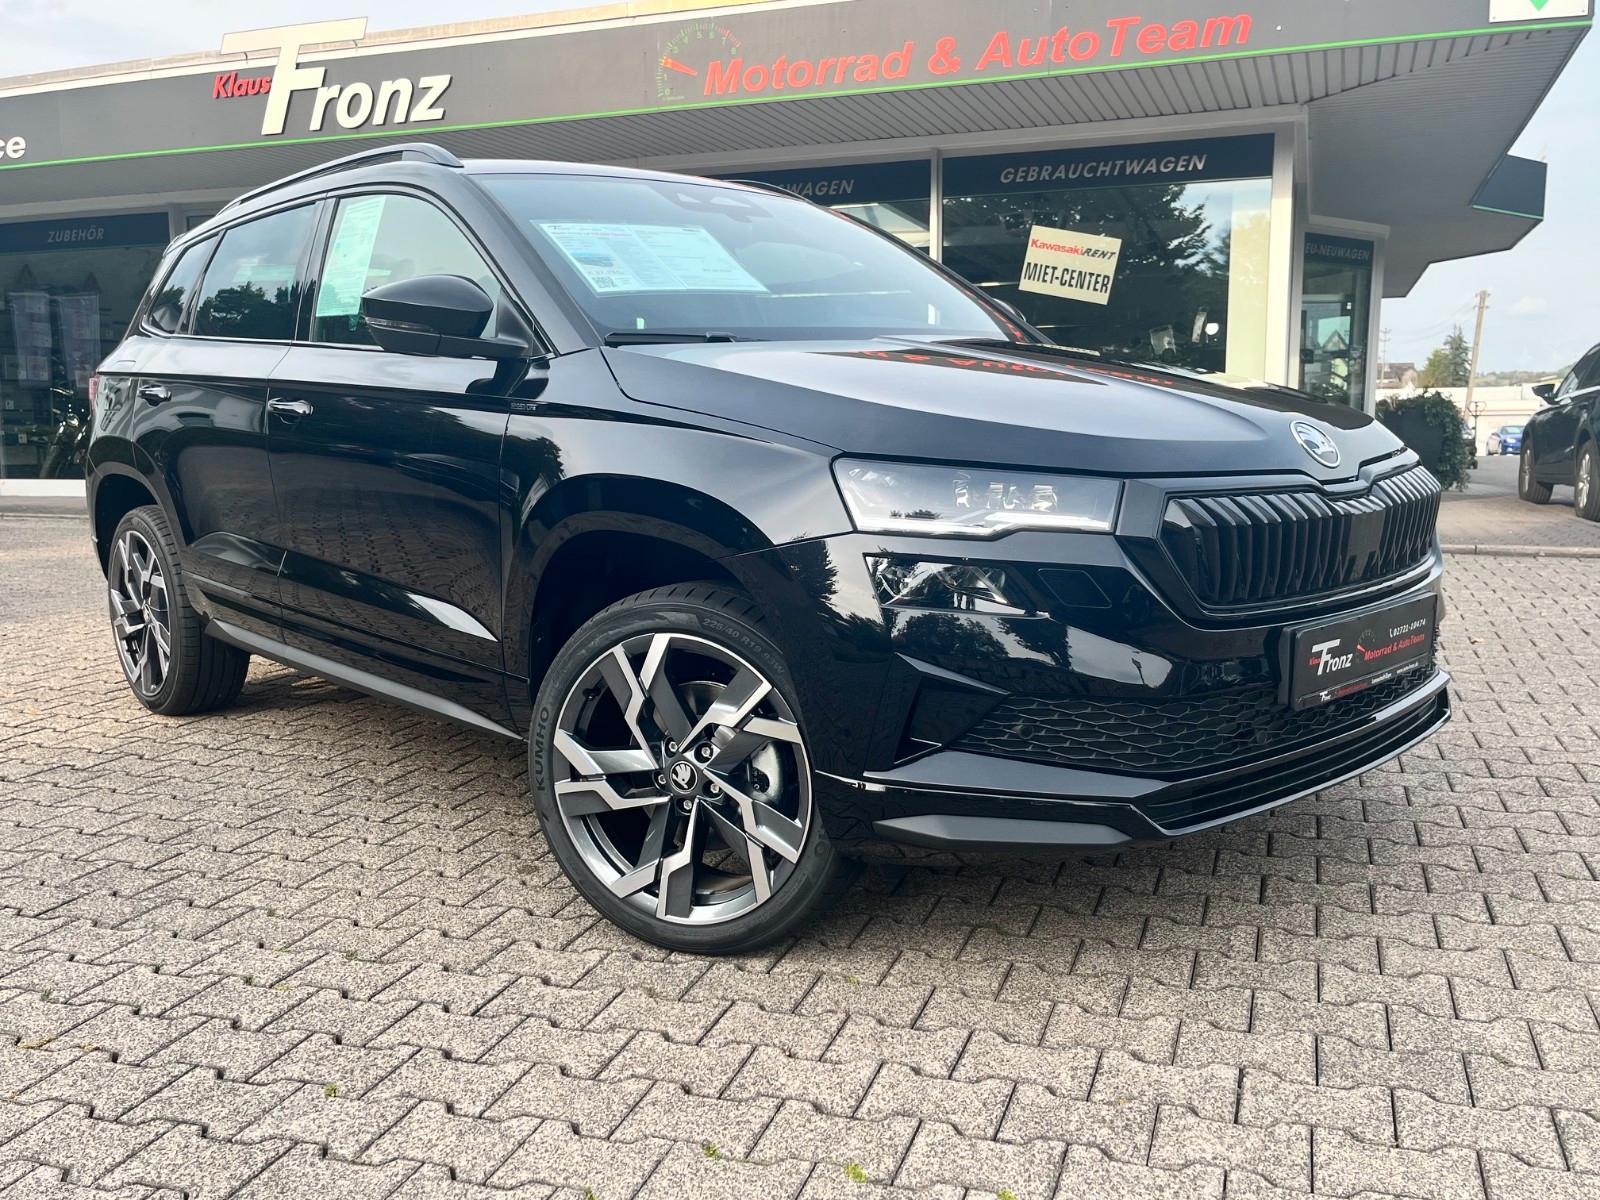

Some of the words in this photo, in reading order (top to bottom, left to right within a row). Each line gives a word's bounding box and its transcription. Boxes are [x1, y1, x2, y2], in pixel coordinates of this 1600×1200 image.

[220, 16, 452, 136] Fronz
[703, 41, 914, 96] Motorrad
[927, 36, 961, 74] &
[212, 71, 273, 100] Klaus
[1000, 153, 1208, 184] GEBRAUCHTWAGEN
[47, 225, 105, 243] ZUBEHÖR
[1023, 262, 1111, 294] MIET-CENTER
[1311, 638, 1353, 676] Fronz
[1364, 646, 1392, 661] Motorrad
[535, 706, 549, 791] KUMHO
